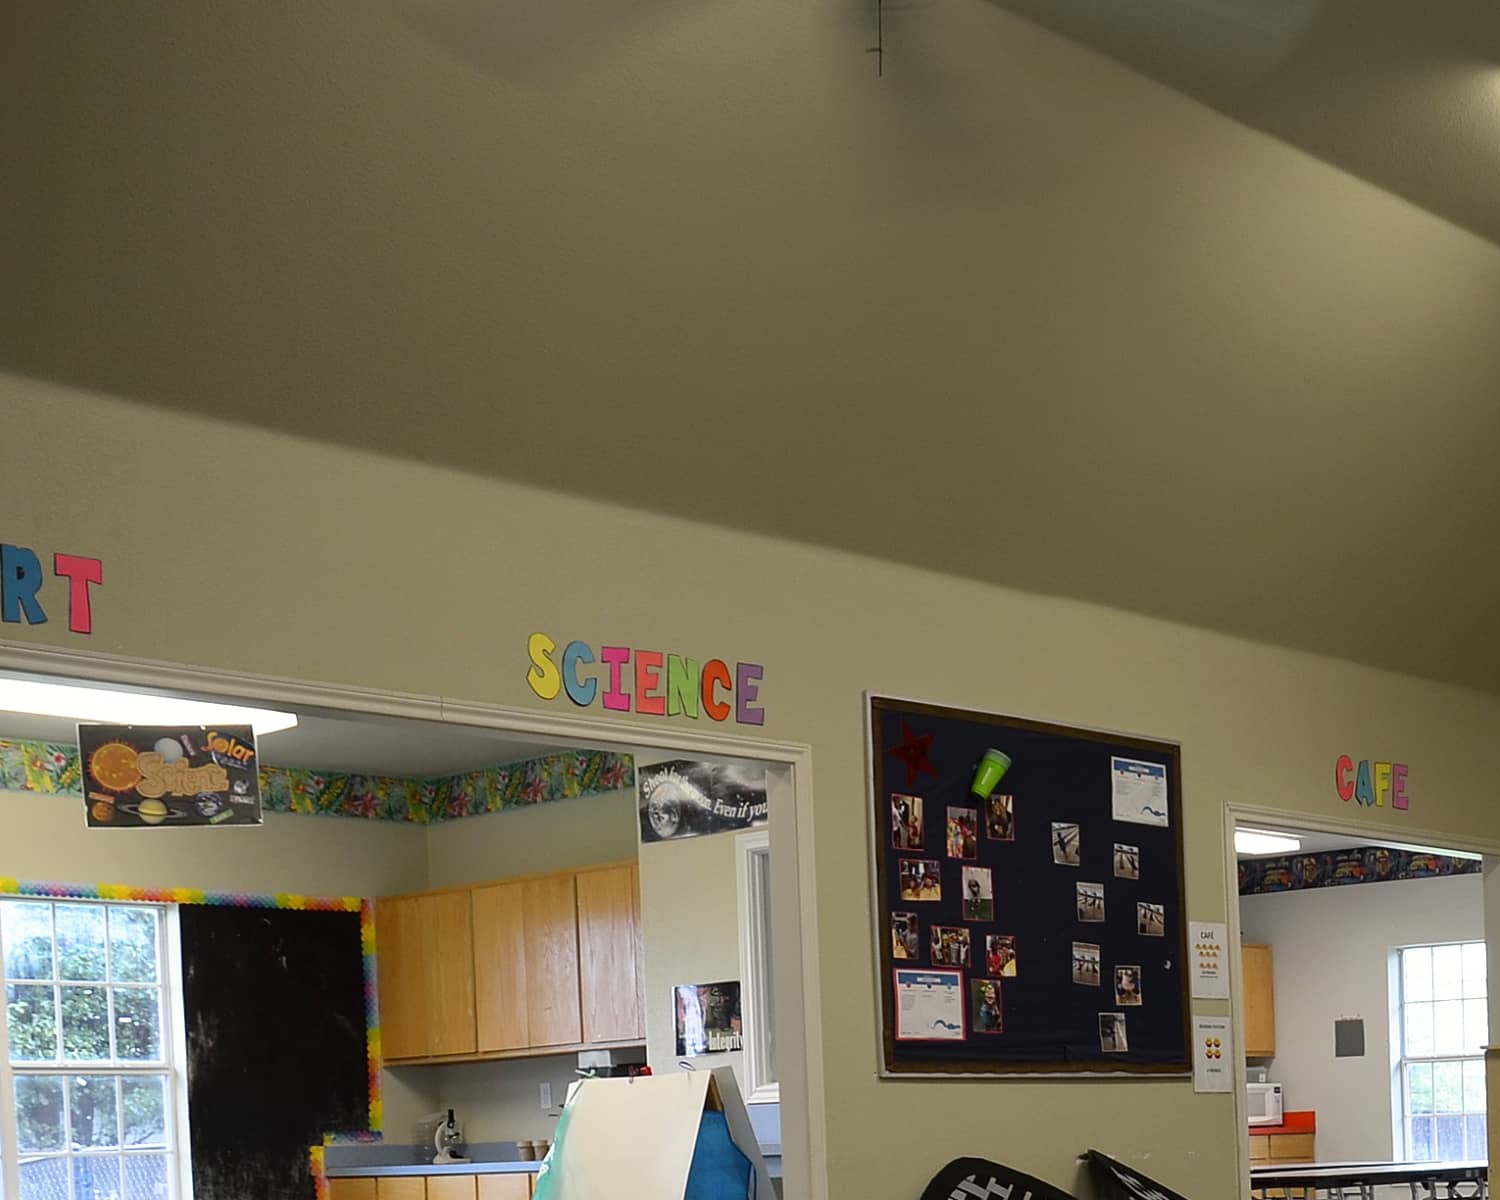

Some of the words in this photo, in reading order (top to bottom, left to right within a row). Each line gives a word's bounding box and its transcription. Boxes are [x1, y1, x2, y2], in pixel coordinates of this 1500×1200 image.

[0, 543, 103, 635] RT
[526, 631, 765, 726] SCIENCE
[201, 731, 255, 765] Solar
[713, 798, 736, 818] Even
[737, 801, 750, 818] if
[1335, 754, 1409, 811] CAFE
